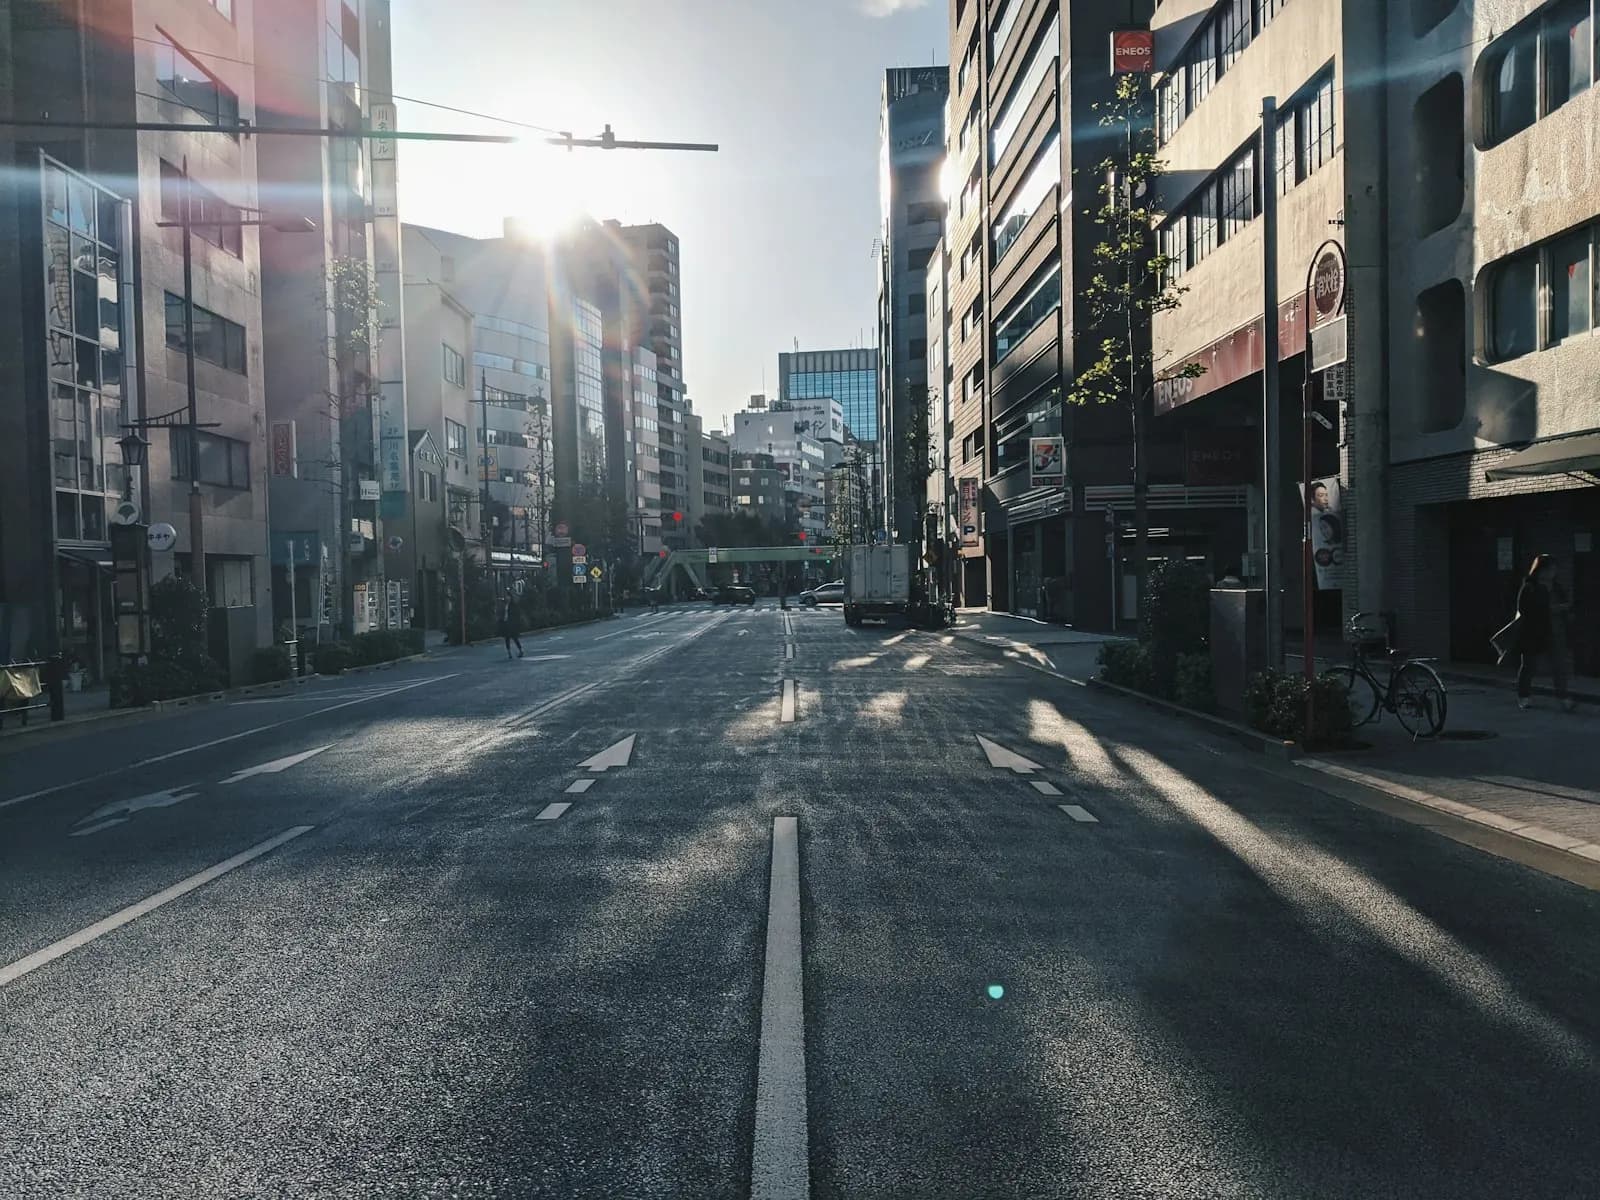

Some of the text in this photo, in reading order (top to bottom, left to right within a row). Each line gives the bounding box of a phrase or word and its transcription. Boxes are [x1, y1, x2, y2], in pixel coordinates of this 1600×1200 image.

[1115, 47, 1151, 56] ENEOS
[1316, 268, 1338, 299] 消火栓
[963, 525, 976, 536] P
